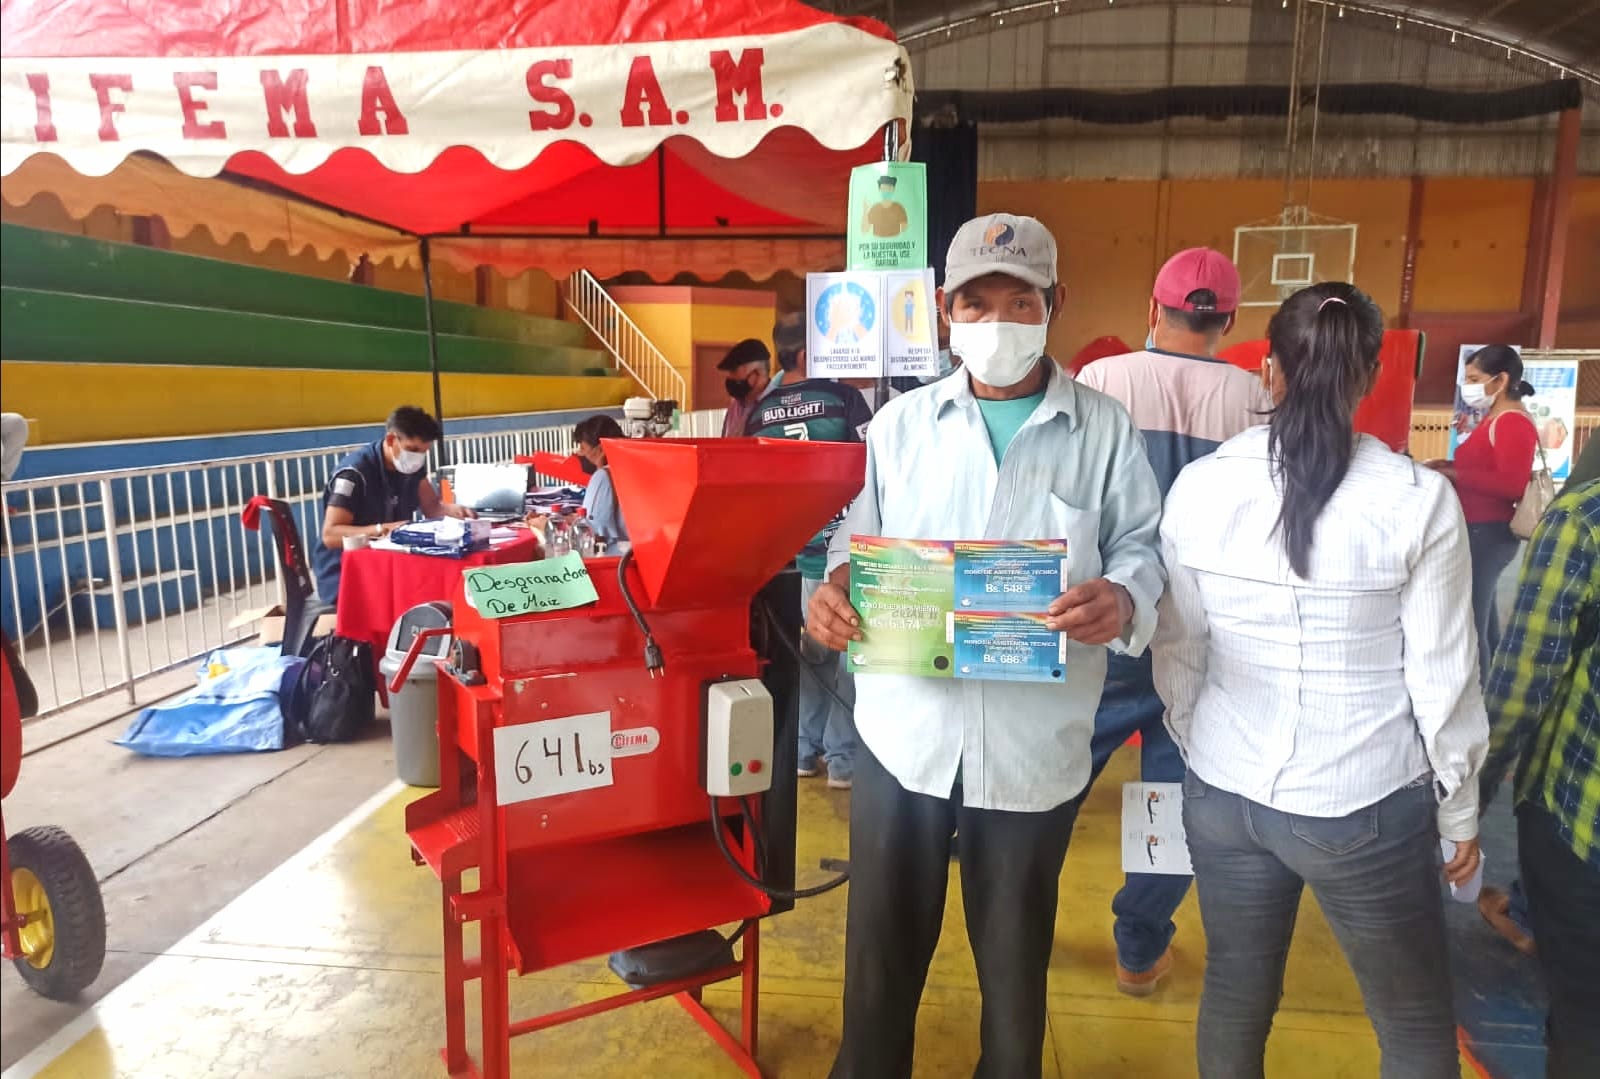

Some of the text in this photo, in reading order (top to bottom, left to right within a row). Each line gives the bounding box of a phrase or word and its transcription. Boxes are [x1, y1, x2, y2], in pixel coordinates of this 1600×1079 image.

[526, 48, 783, 131] S.A.M.
[871, 242, 879, 250] SU
[880, 241, 911, 250] SEGURIDAD
[970, 246, 1026, 257] TECNA
[763, 402, 821, 421] BUD LIGHT
[985, 583, 1000, 593] Bs.
[487, 598, 516, 614] De
